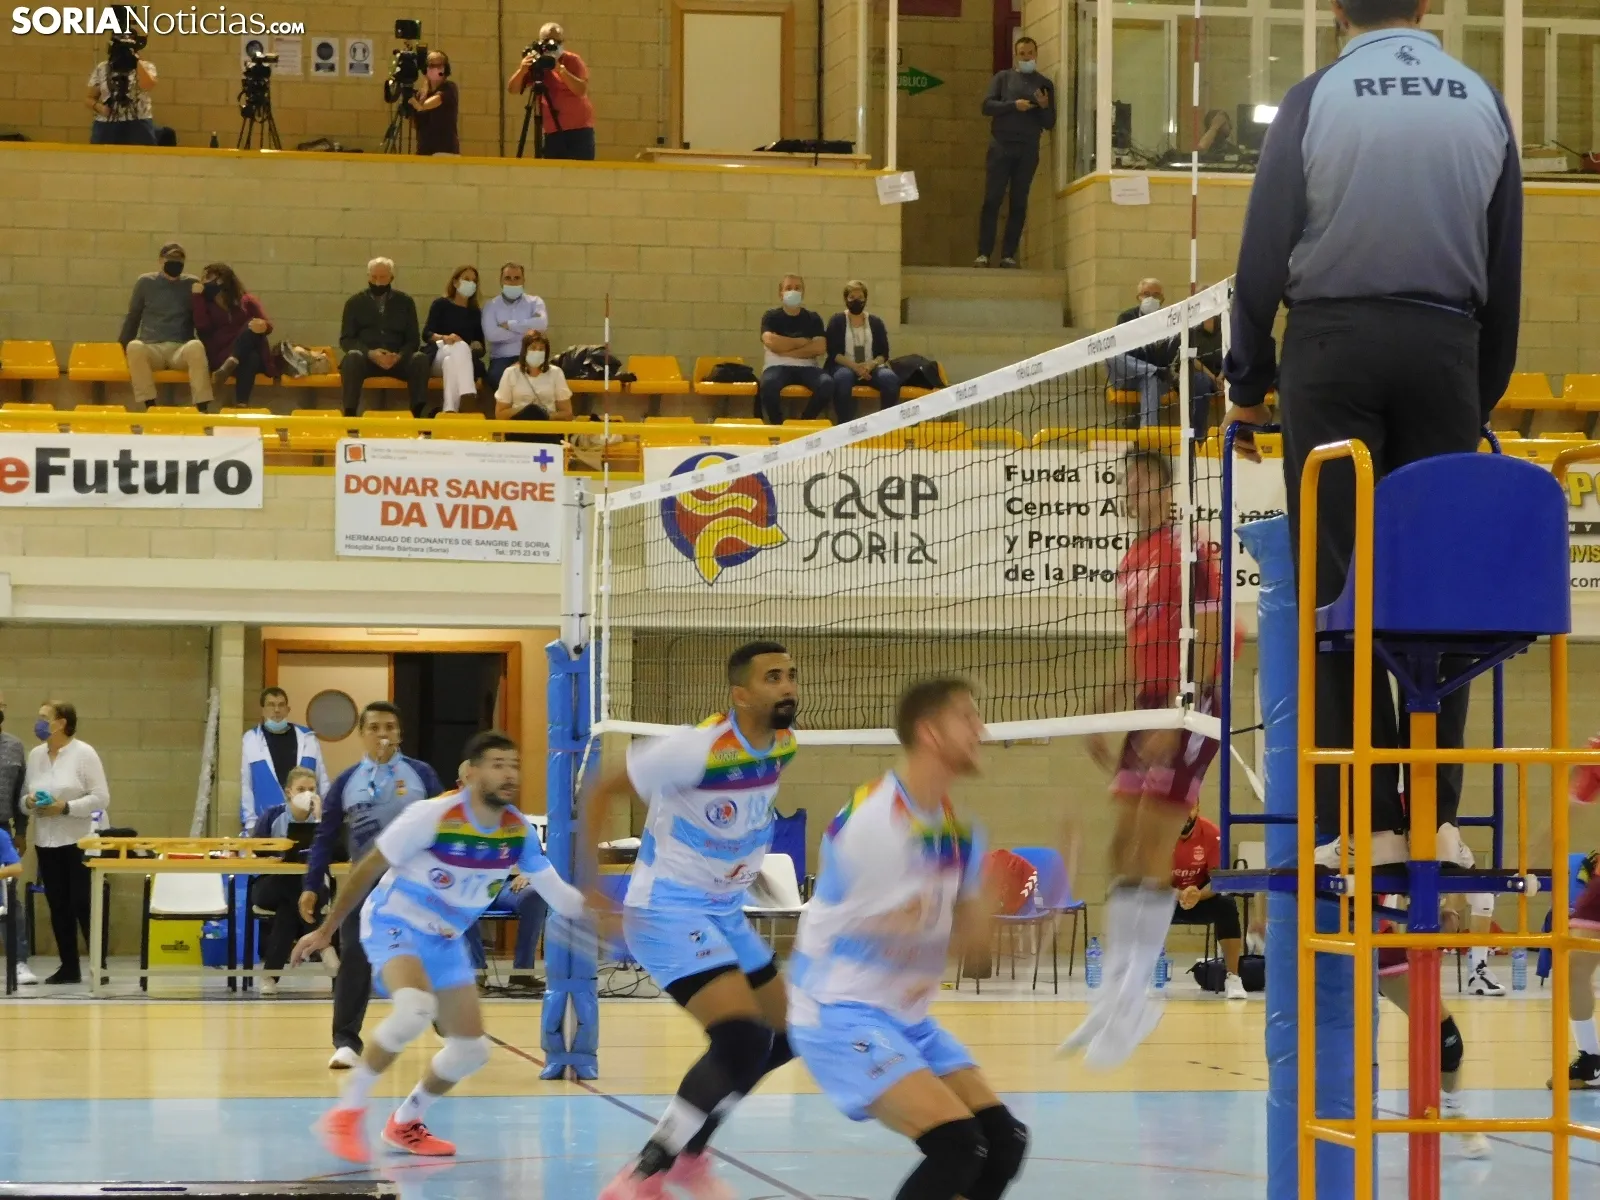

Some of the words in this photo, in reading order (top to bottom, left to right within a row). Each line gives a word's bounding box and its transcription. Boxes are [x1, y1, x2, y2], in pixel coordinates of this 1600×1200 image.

[1353, 77, 1468, 99] RFEVB
[0, 447, 253, 495] eFuturo
[344, 474, 439, 497] DONAR
[446, 478, 555, 502] SANGRE
[380, 501, 428, 528] DA
[436, 503, 518, 531] VIDA
[1006, 497, 1090, 516] Centro
[345, 534, 398, 543] HERMANDAD
[400, 536, 412, 544] DE
[414, 536, 460, 546] DONANTES
[475, 539, 509, 548] SANGRE
[512, 540, 523, 548] DE
[525, 541, 550, 549] SORIA
[345, 543, 374, 552] Hospital
[1004, 533, 1019, 554] y
[1028, 531, 1130, 550] Promoci
[1004, 566, 1035, 582] de
[1045, 563, 1064, 581] la
[1072, 564, 1115, 583] Pro
[1236, 569, 1260, 587] So
